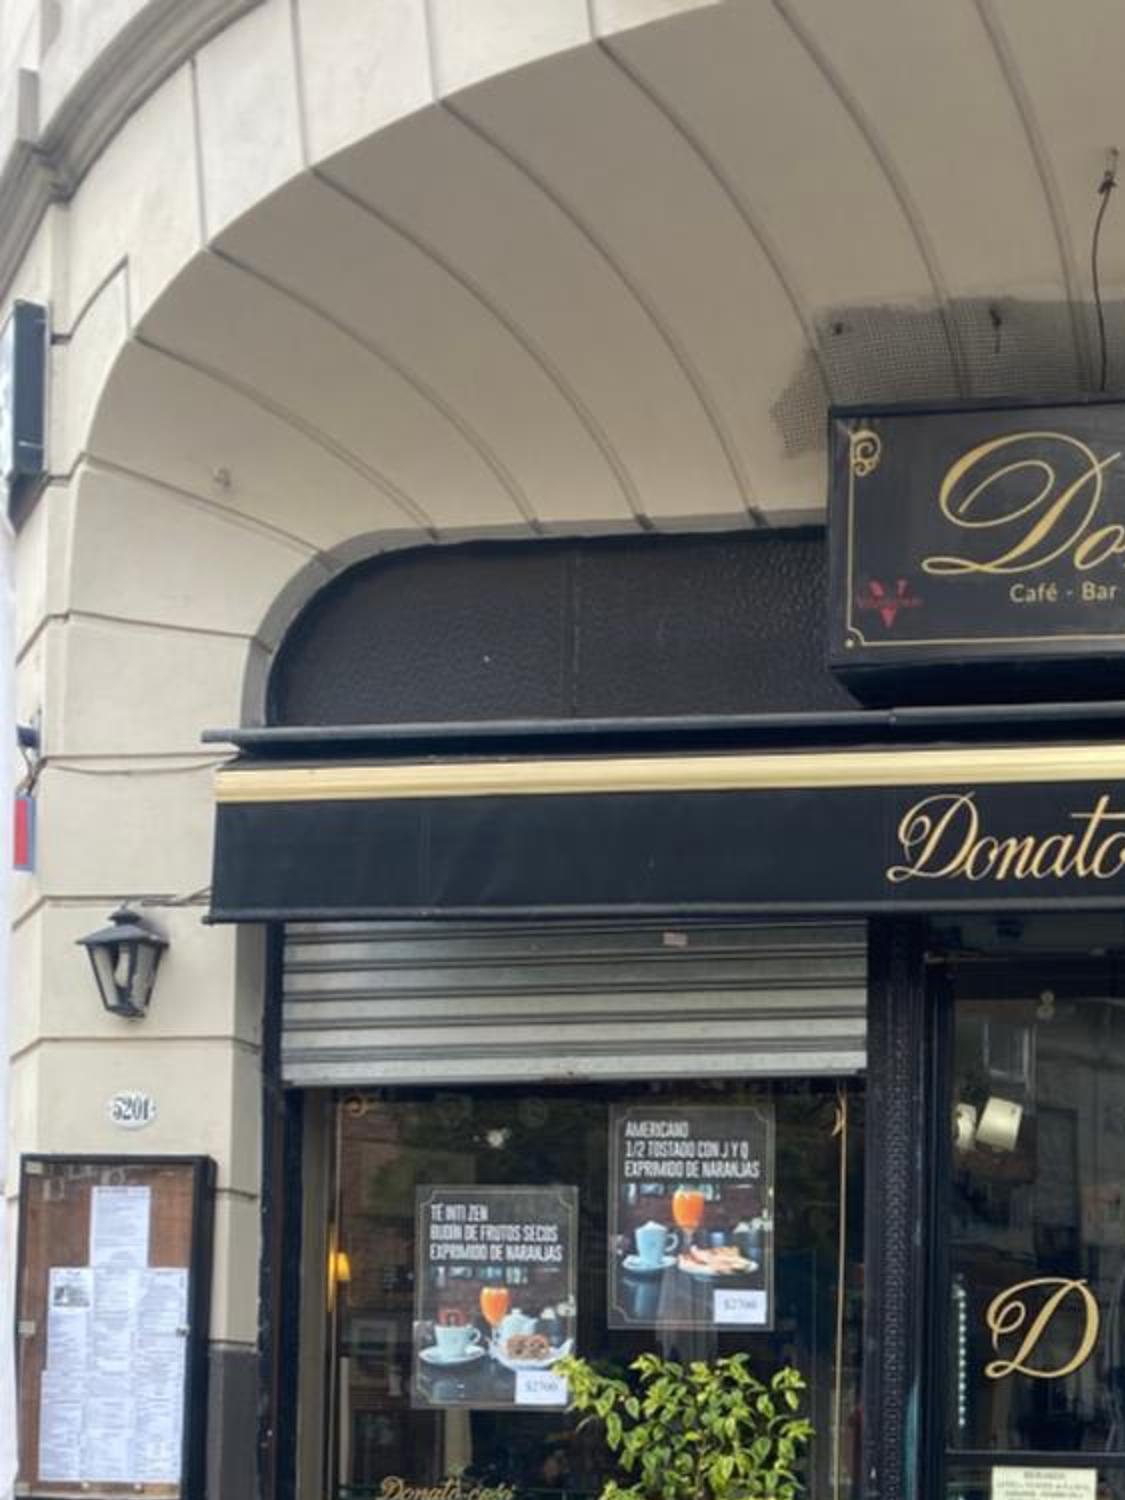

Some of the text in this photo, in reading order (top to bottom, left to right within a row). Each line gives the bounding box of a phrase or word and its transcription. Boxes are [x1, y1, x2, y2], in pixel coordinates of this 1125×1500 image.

[1009, 582, 1058, 603] Café
[1081, 580, 1118, 601] Bar
[685, 1160, 700, 1179] DE
[701, 1160, 761, 1179] NARANJAS
[463, 1224, 478, 1242] DE
[489, 1243, 504, 1262] DE
[505, 1243, 563, 1263] NARANJAS
[984, 1276, 1100, 1379] D
